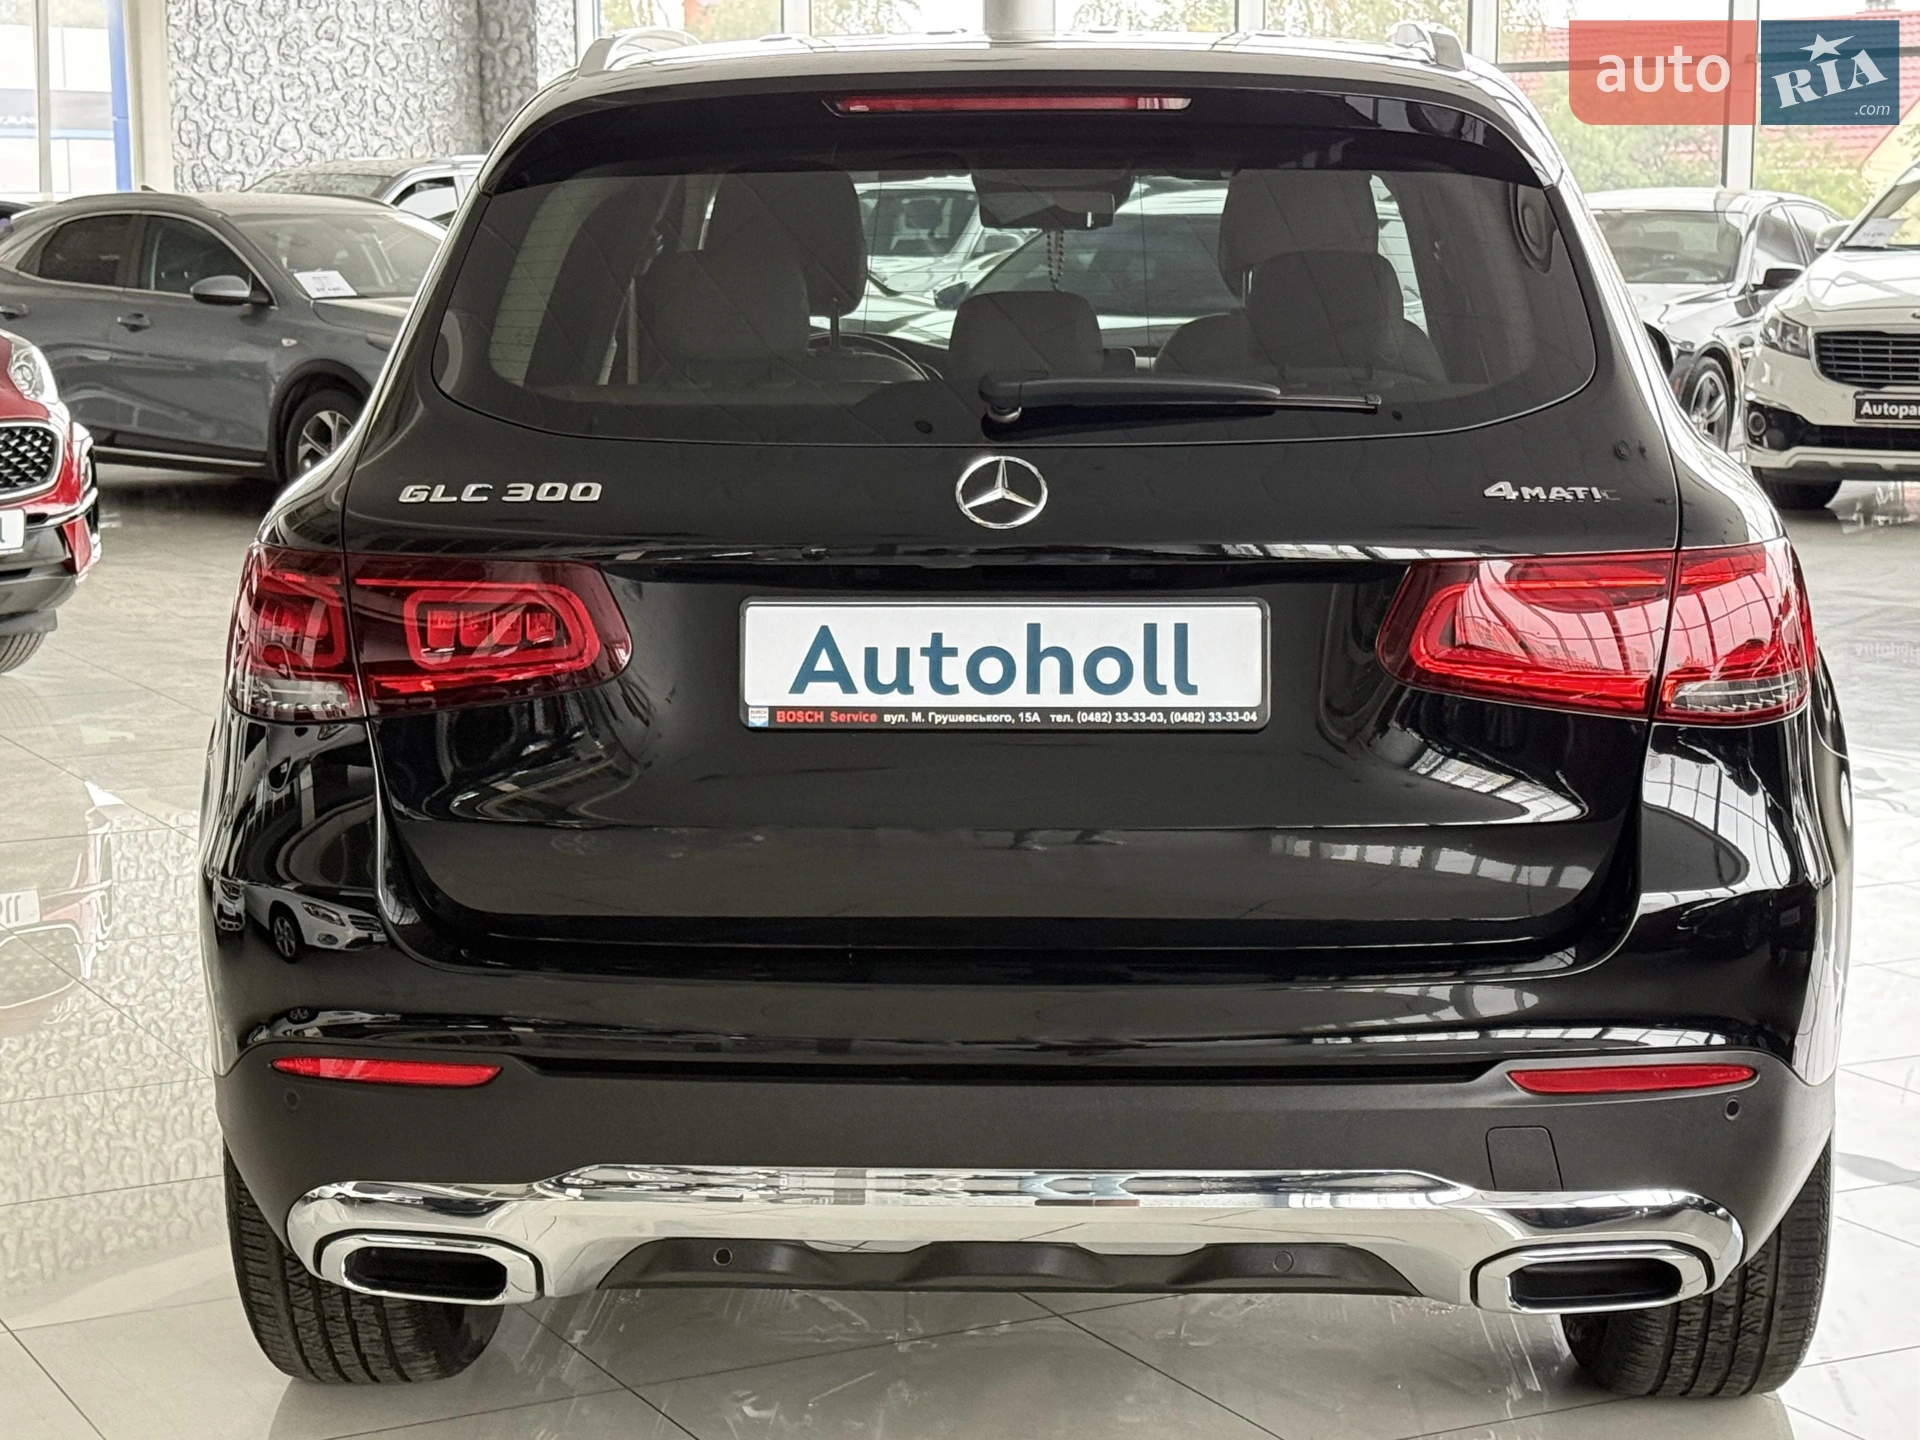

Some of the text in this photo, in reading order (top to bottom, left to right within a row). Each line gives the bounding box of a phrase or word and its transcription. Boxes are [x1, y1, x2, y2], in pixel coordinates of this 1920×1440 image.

[398, 482, 602, 503] GLC 300
[788, 622, 1198, 696] Autoholl
[776, 710, 825, 723] BOSCH
[830, 710, 878, 723] Service
[883, 713, 909, 725] вул.
[911, 711, 925, 723] М.
[928, 711, 1016, 725] Грушевського,
[1049, 713, 1074, 723] тел.
[1076, 710, 1113, 724] (0482)
[1115, 711, 1168, 725] 33-33-03,
[1170, 710, 1206, 724] (0482)
[1208, 711, 1258, 723] 33-33-04
